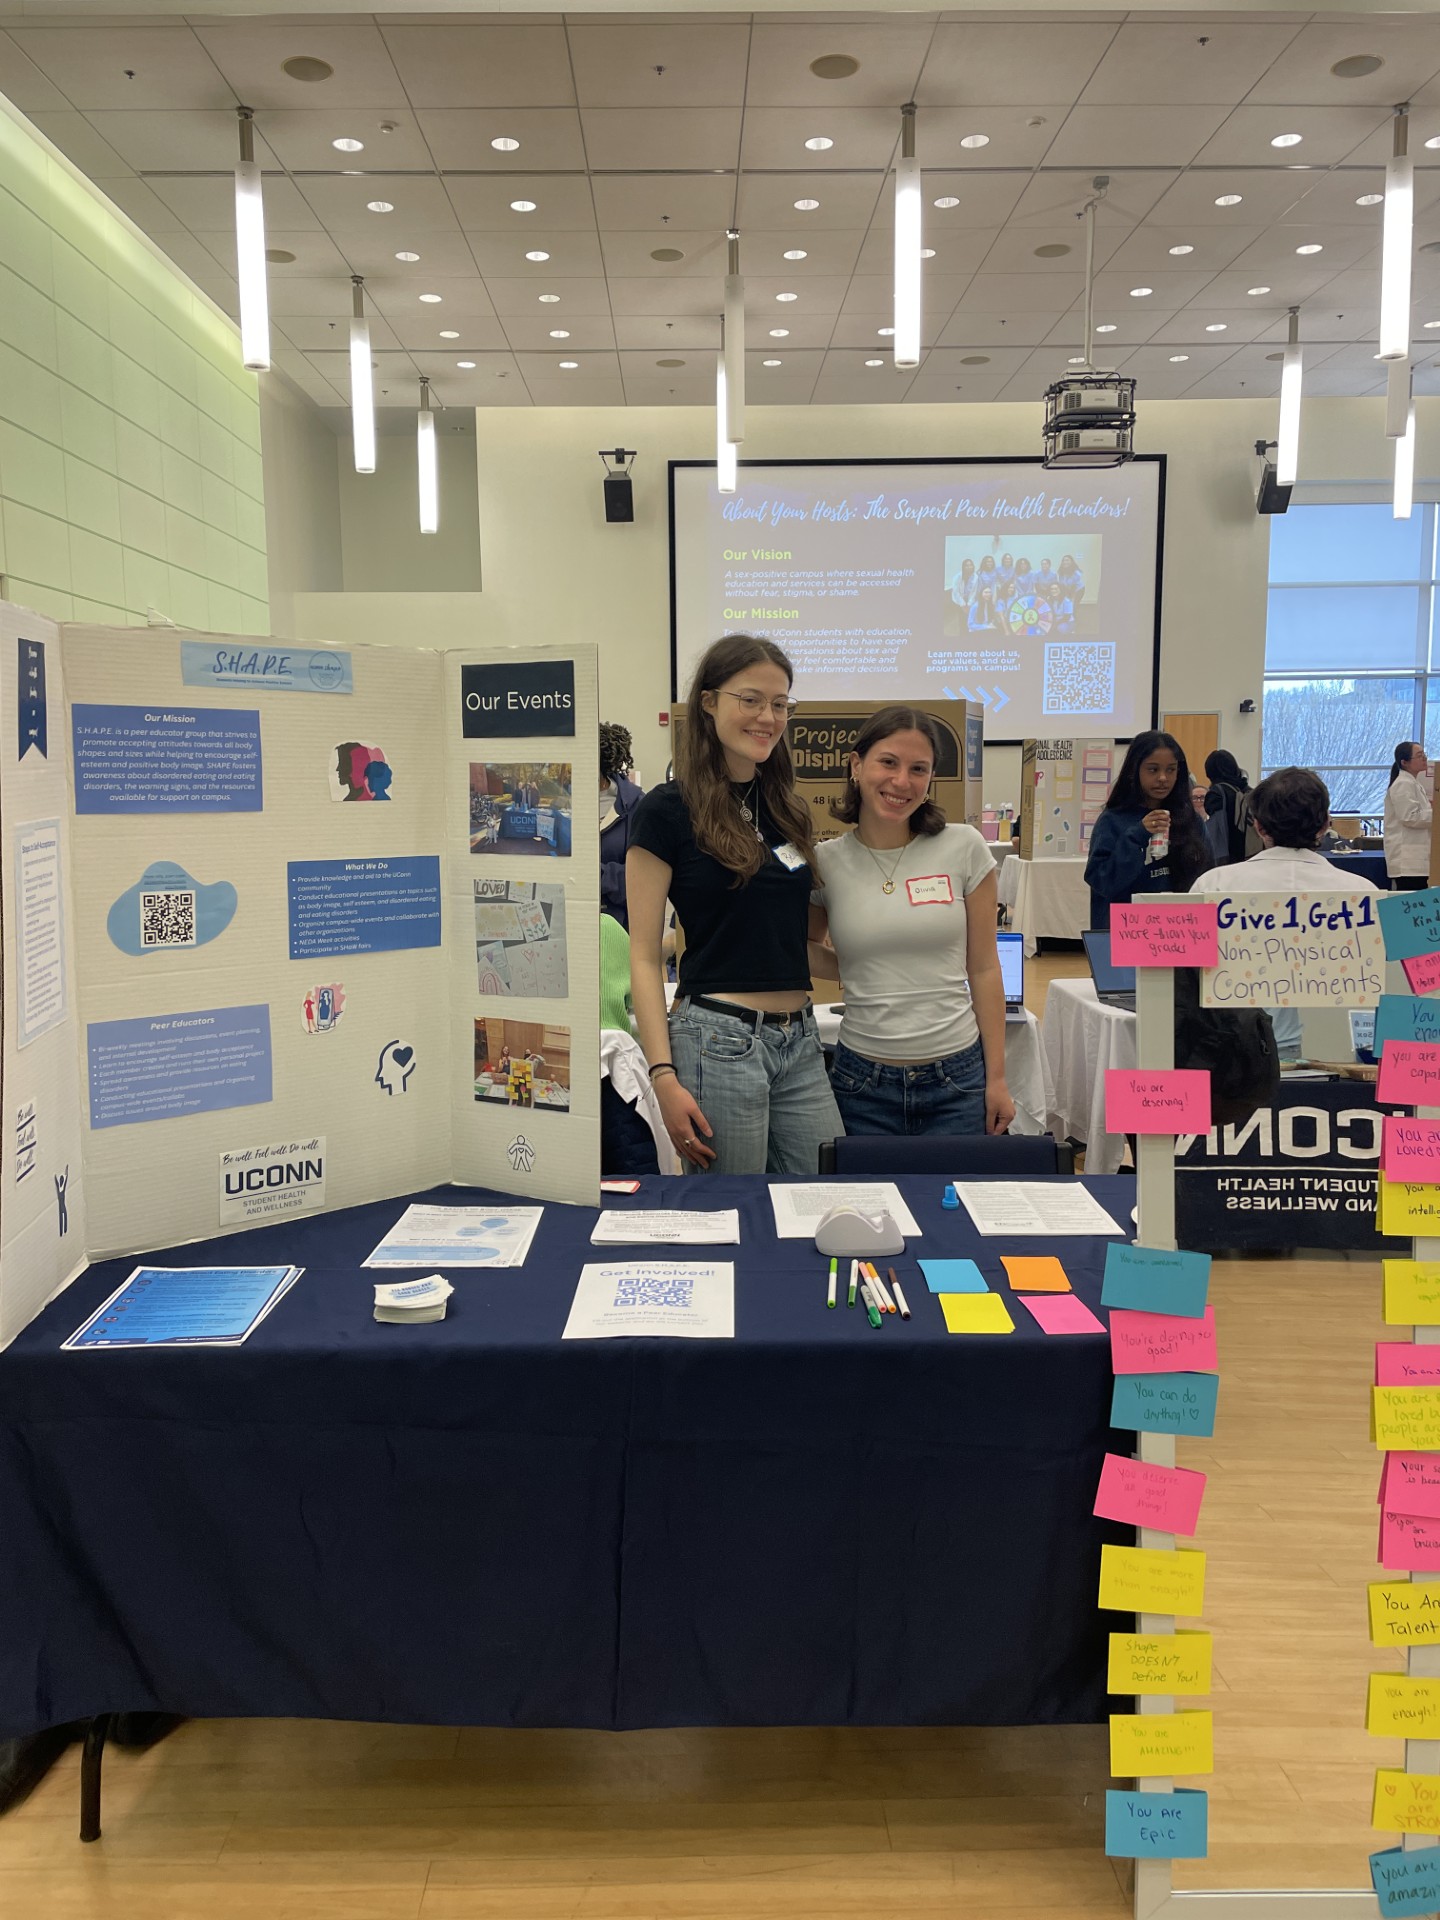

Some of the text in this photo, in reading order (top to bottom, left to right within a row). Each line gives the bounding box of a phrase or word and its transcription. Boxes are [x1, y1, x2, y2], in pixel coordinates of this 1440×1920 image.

[723, 492, 1130, 526] About Your Hosts: The Sexpert Peer Health Educators!
[723, 549, 792, 560] Our Vision
[725, 569, 914, 579] A sex-positive campus where sexual health
[725, 579, 768, 587] education
[771, 579, 788, 587] and
[790, 579, 825, 587] services
[859, 578, 901, 586] accessed
[725, 589, 759, 597] without
[761, 588, 781, 597] fear,
[783, 589, 815, 598] stigma,
[829, 588, 860, 596] shame.
[723, 608, 799, 619] Our Mission
[866, 628, 912, 636] education,
[928, 650, 952, 658] Learn
[1008, 651, 1020, 659] us,
[982, 657, 999, 665] and
[212, 651, 292, 675] S.H.A.P.E
[926, 665, 969, 674] programs
[985, 664, 1021, 673] campus!
[466, 690, 572, 711] Our Events
[144, 713, 196, 723] Our Mission
[150, 729, 184, 737] educator
[185, 730, 207, 738] group
[224, 731, 248, 739] strives
[793, 724, 861, 749] Projec
[83, 739, 117, 747] promote
[118, 739, 156, 748] accepting
[158, 740, 192, 748] attitudes
[235, 742, 253, 750] body
[1053, 740, 1073, 750] HEALTH
[794, 748, 850, 771] Displa
[1037, 750, 1073, 760] ADOLESCENCE
[812, 796, 825, 805] 48
[345, 863, 365, 871] What
[476, 881, 505, 896] LOVED
[1145, 913, 1198, 925] are worth
[1217, 898, 1276, 931] Give
[1357, 895, 1375, 928] 1
[1119, 928, 1210, 944] more than your
[1217, 930, 1363, 966] Non-Physical
[1213, 965, 1382, 1004] Compliments
[1412, 1003, 1435, 1024] You
[150, 1016, 215, 1031] Peer Educators
[1418, 1052, 1437, 1062] are
[1129, 1080, 1164, 1093] You are
[1142, 1092, 1190, 1112] deserving!
[1396, 1128, 1422, 1143] You
[222, 1139, 318, 1166] Be well. Feel well. Do well.
[225, 1158, 322, 1194] UCONN
[243, 1190, 306, 1208] STUDENT HEALTH
[246, 1199, 303, 1215] AND WELLNESS
[600, 1269, 632, 1277] Get
[1147, 1342, 1178, 1363] good!
[1134, 1382, 1197, 1404] You can do
[1383, 1391, 1430, 1406] You are
[1143, 1408, 1186, 1426] anything!
[1378, 1421, 1418, 1439] people
[1401, 1461, 1425, 1473] Your
[1382, 1592, 1410, 1610] You
[1126, 1639, 1159, 1653] Shape
[1132, 1669, 1167, 1682] Define
[1413, 1687, 1430, 1696] are
[1131, 1726, 1168, 1738] You are
[1411, 1780, 1438, 1800] You
[1126, 1801, 1183, 1820] You Are
[1408, 1804, 1434, 1814] are
[1140, 1827, 1176, 1844] Epic
[1415, 1861, 1437, 1873] are
